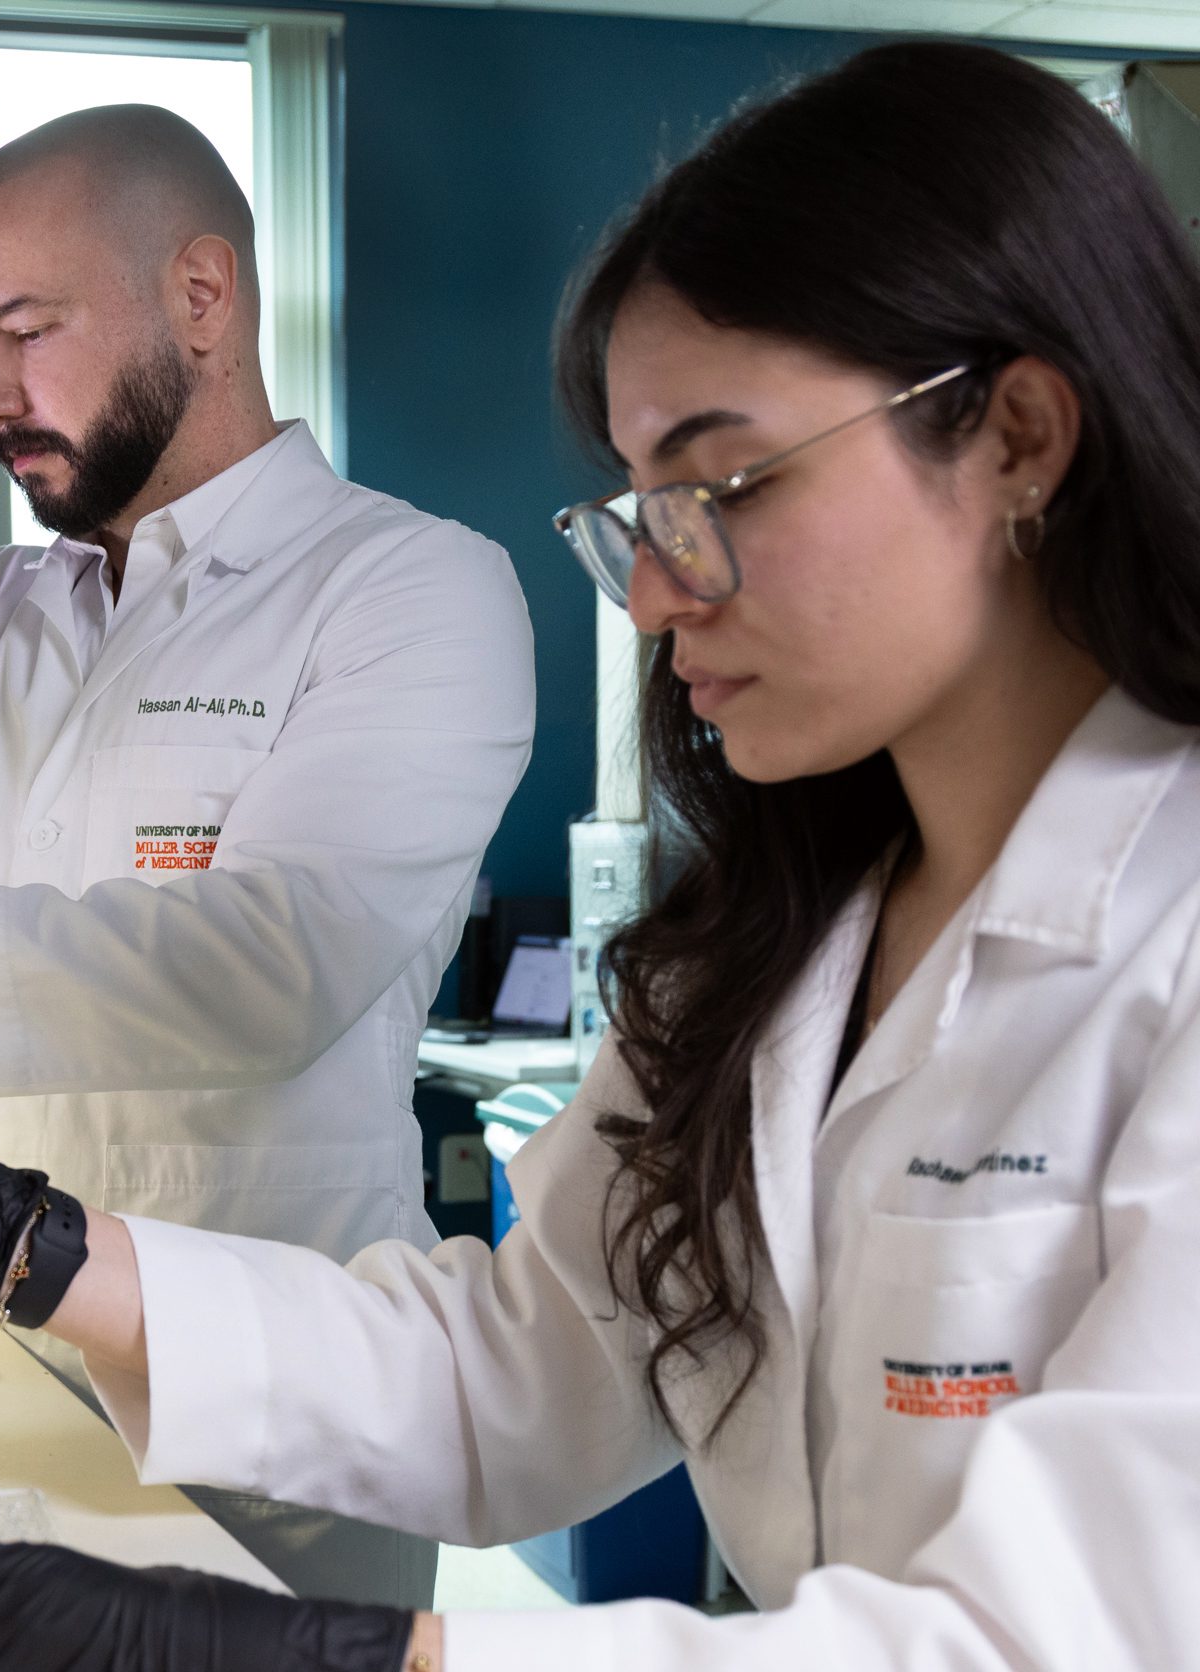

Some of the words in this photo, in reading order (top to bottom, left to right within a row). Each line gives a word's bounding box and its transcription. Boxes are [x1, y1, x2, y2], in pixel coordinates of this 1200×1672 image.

[138, 698, 181, 714] Hassan
[184, 696, 225, 717] Al-Ali,
[136, 826, 185, 837] UNIVERSITY
[186, 826, 201, 837] OF
[202, 826, 221, 837] MIA
[136, 842, 178, 854] MILLER
[184, 842, 217, 854] SCH
[135, 856, 146, 868] of
[942, 1375, 1020, 1396] SCHOOL
